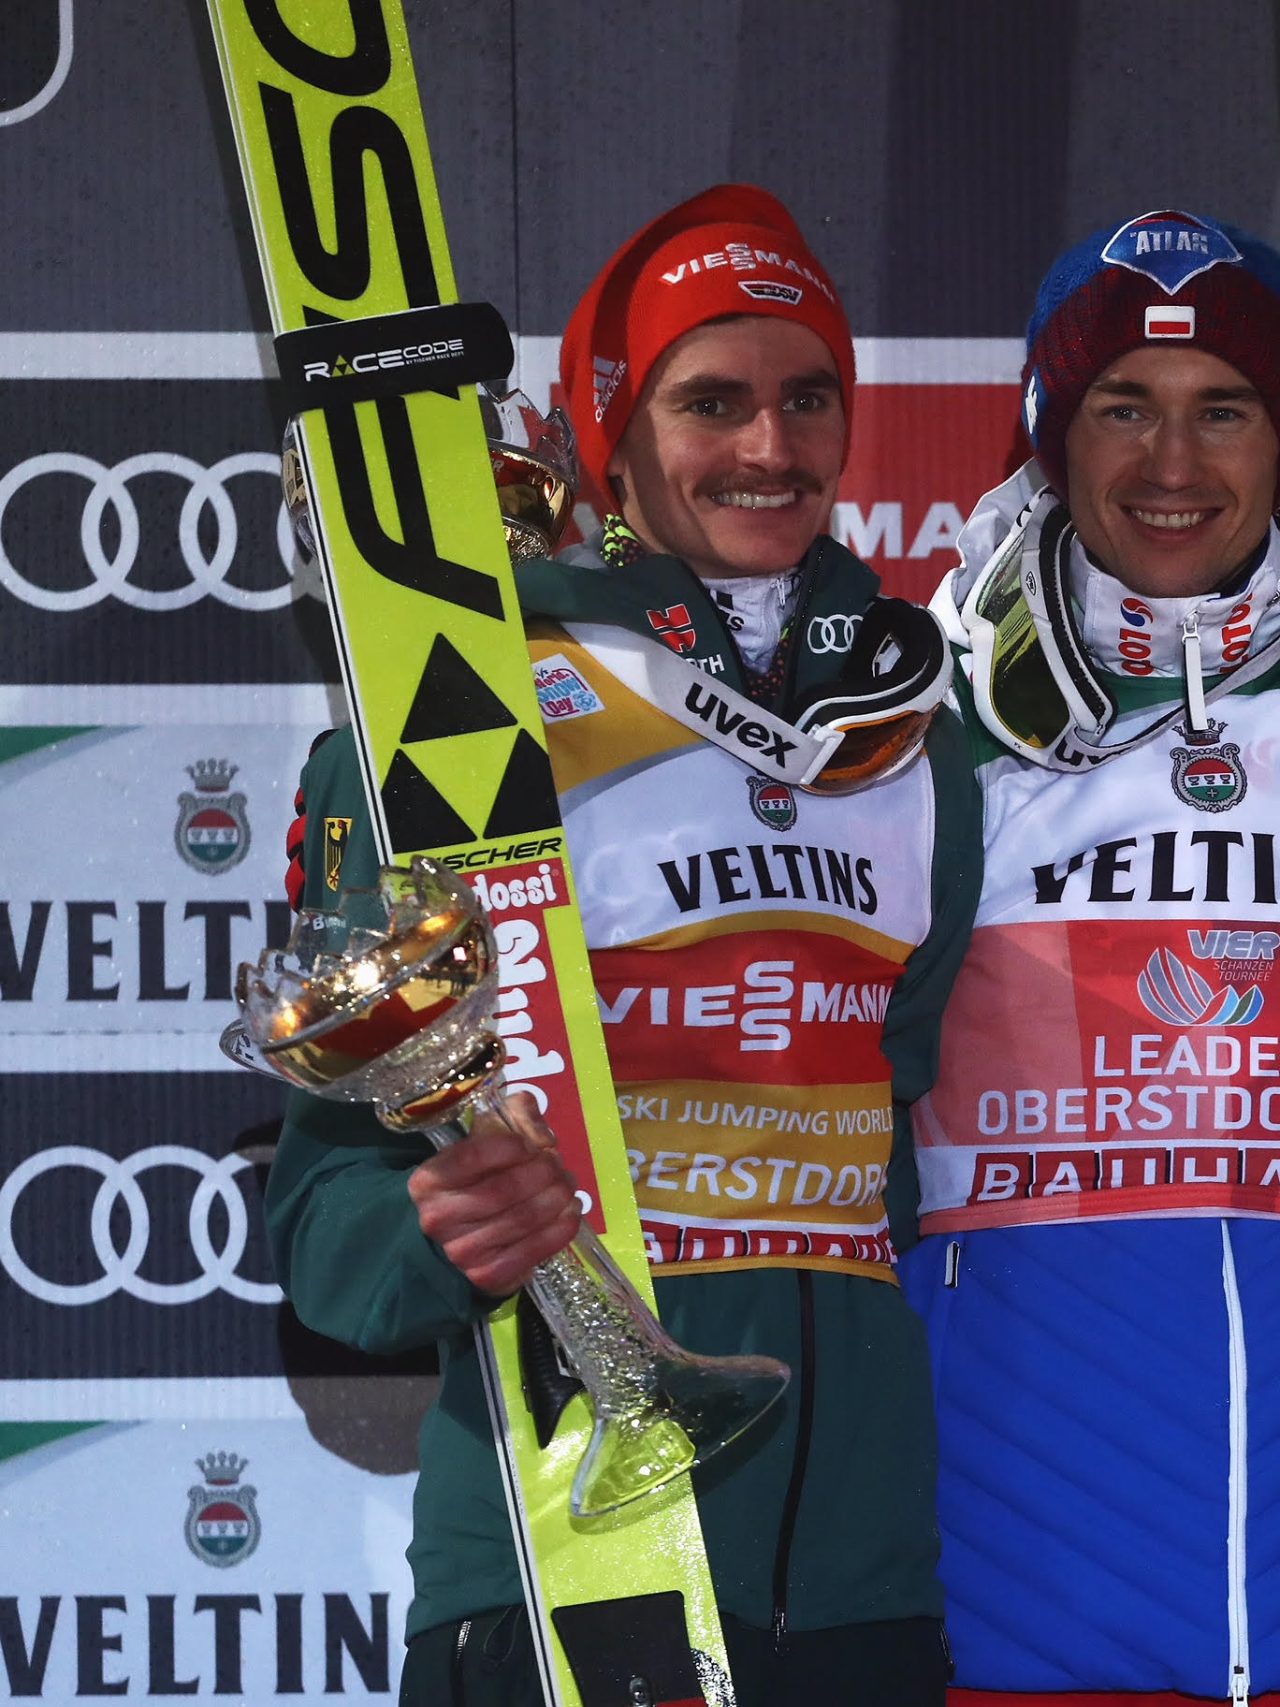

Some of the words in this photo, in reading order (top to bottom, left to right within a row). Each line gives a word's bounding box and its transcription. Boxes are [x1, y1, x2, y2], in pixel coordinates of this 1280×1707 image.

[684, 682, 798, 768] uvex
[657, 844, 878, 916] VELTINS
[1187, 930, 1280, 960] VIER
[1213, 961, 1273, 971] SCHANZEN
[1219, 971, 1271, 981] TOURNEE
[617, 1094, 668, 1122] SKI
[677, 1101, 829, 1135] JUMPING
